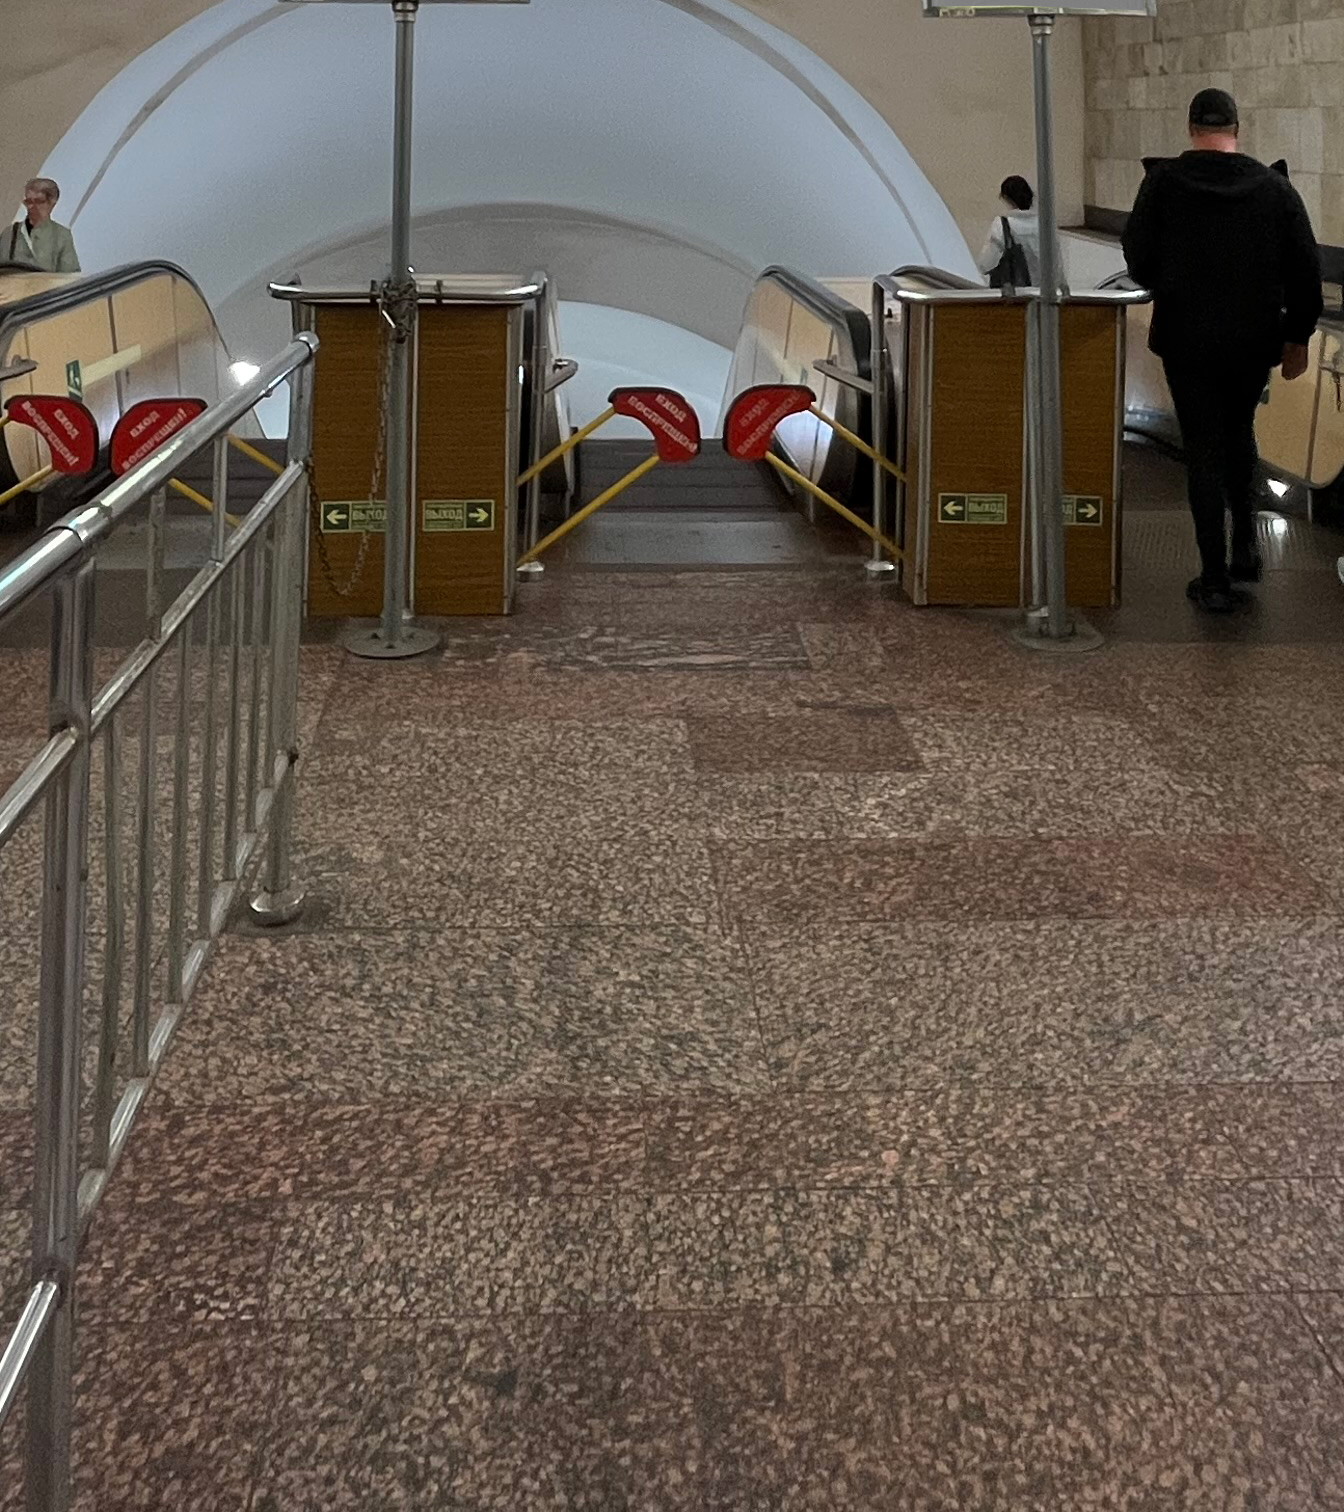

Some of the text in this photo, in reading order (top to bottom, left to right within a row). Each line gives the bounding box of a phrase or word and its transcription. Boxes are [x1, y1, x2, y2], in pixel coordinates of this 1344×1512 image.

[53, 408, 80, 440] ВХОД
[129, 410, 161, 438] ВХОД
[654, 393, 687, 424] ВХОД
[21, 400, 80, 467] ВОСПРЕЩЕН!
[121, 407, 188, 471] ВОСПРЕЩЕН!
[425, 509, 463, 521] ВЫХОД
[968, 502, 1004, 514] ВЫХОД
